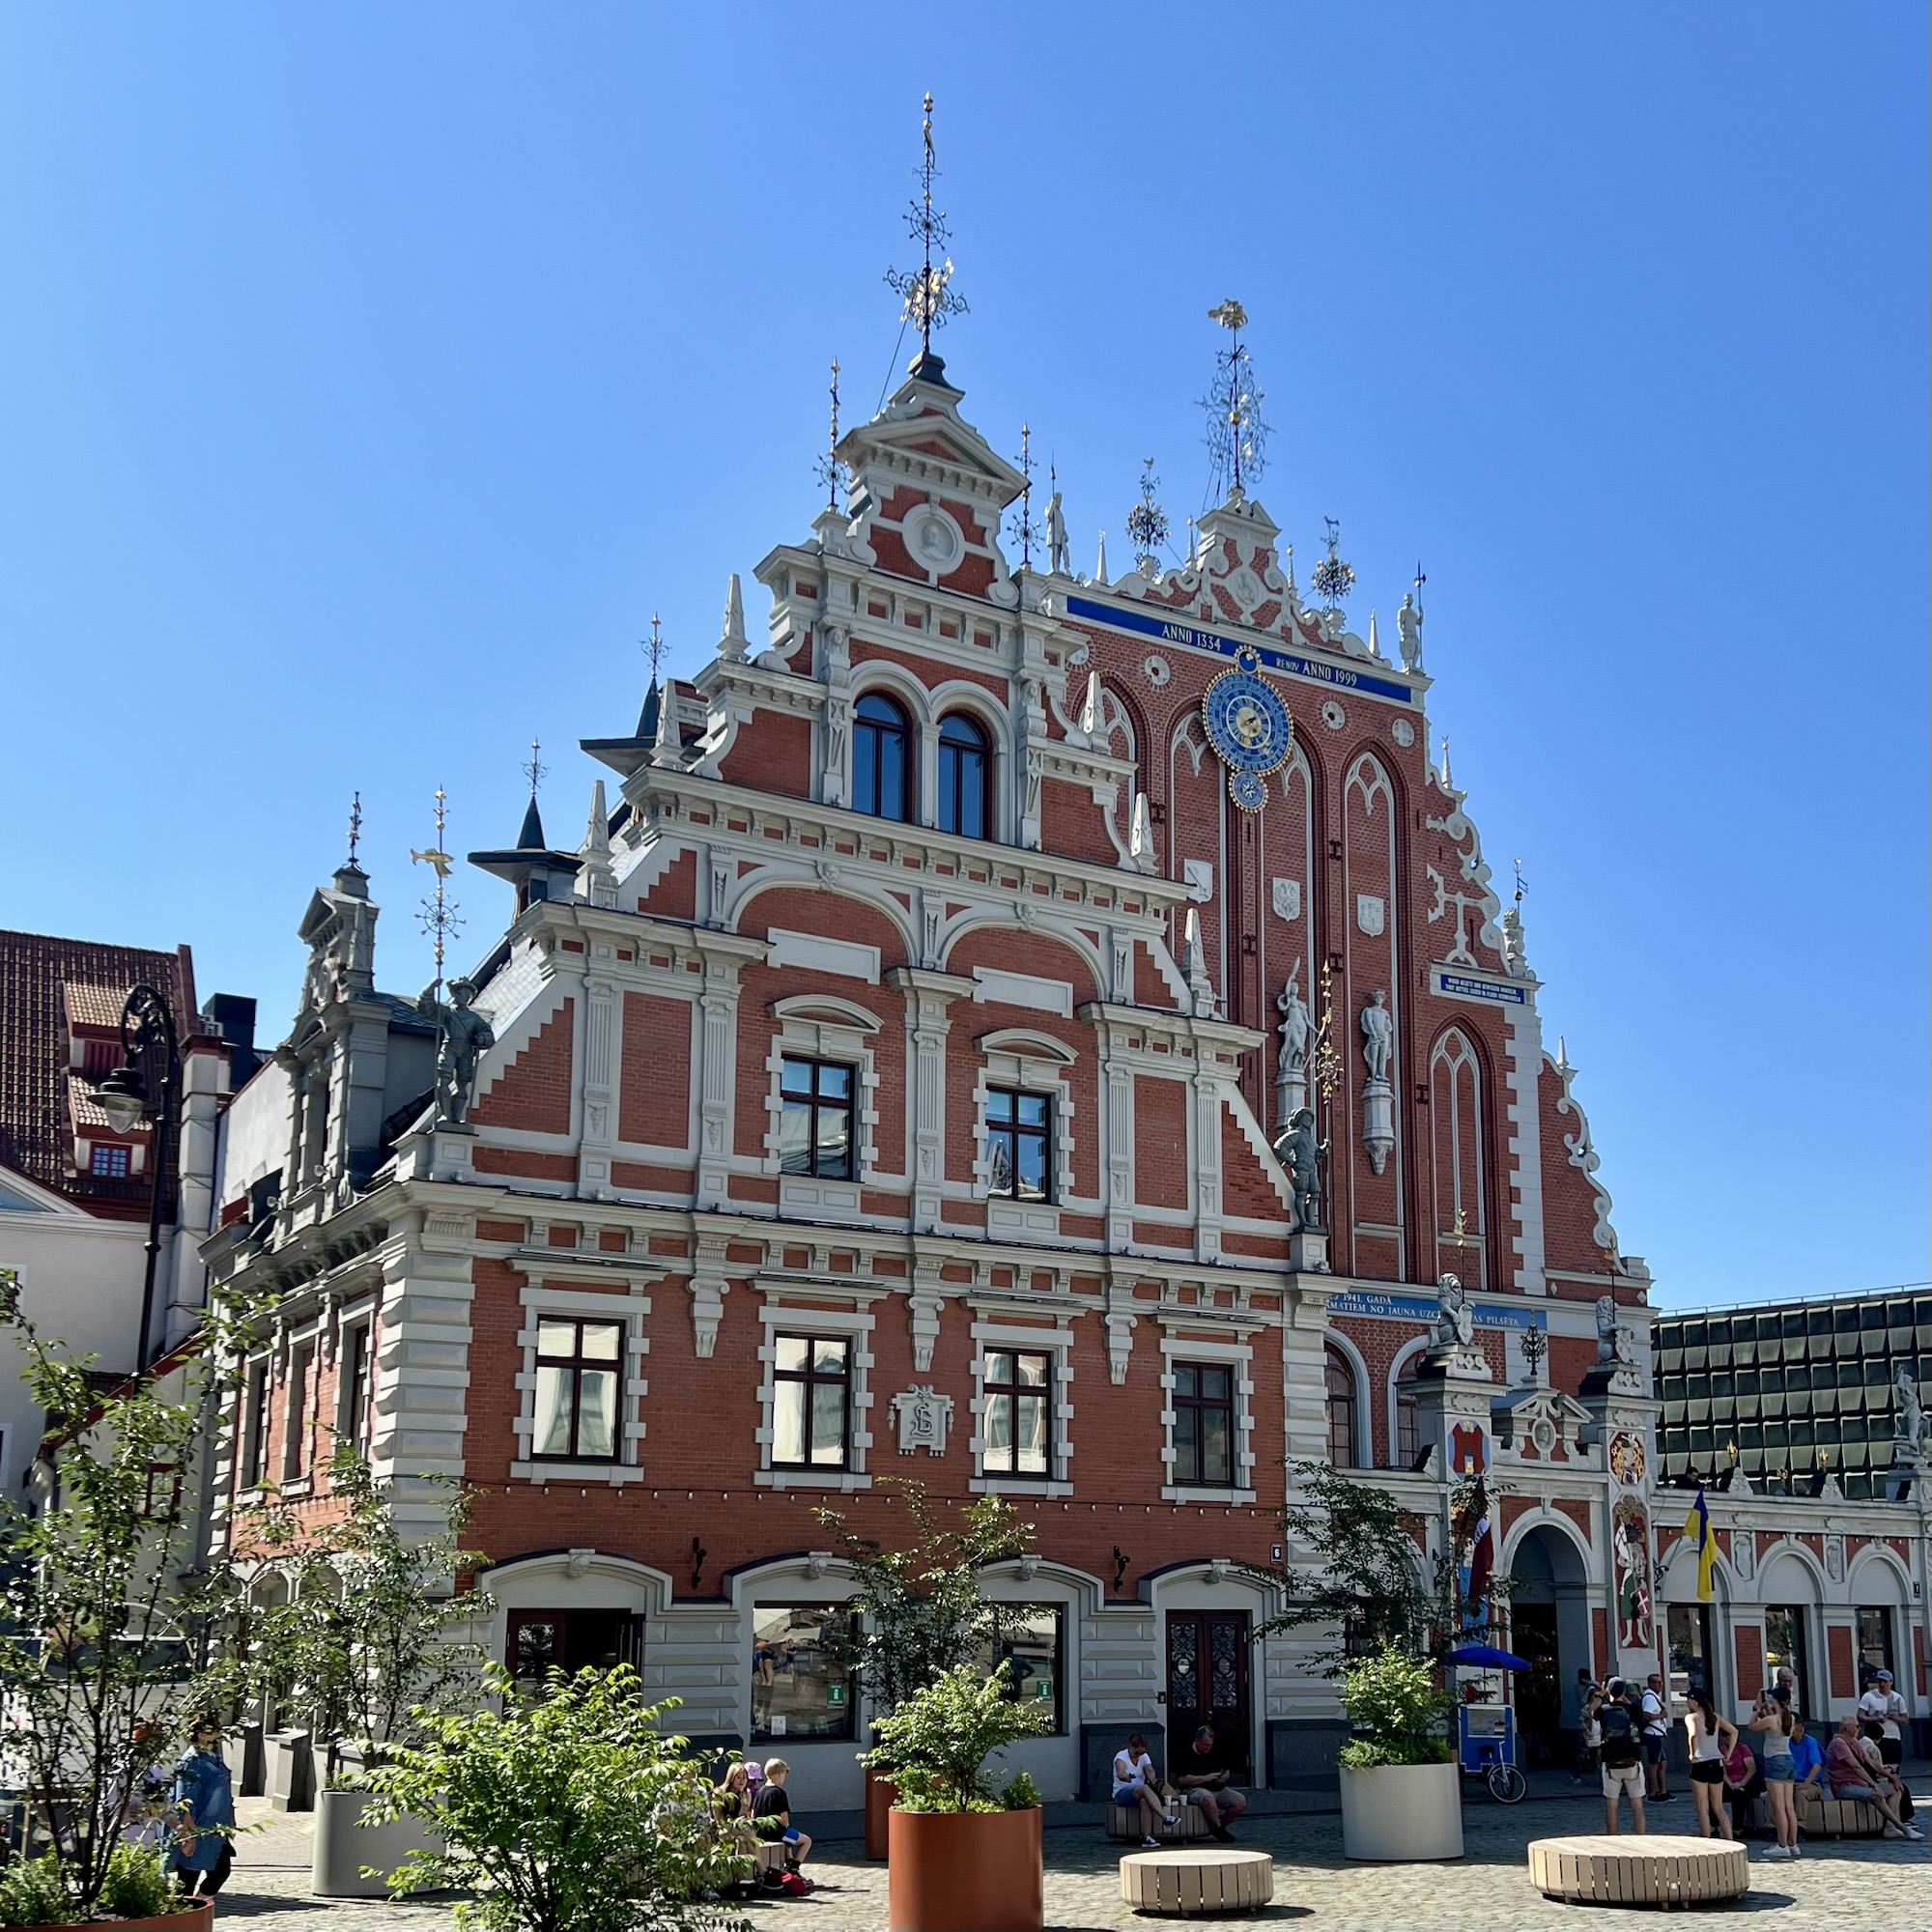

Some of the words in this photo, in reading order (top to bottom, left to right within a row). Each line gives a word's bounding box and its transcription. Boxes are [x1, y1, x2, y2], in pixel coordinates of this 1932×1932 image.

[1161, 624, 1192, 644] ANNO
[1197, 633, 1221, 652] 1334
[1276, 657, 1300, 672] RENOV
[1302, 661, 1331, 681] ANNO
[1335, 669, 1357, 687] 1999
[1370, 1304, 1384, 1314] NO
[1388, 1306, 1416, 1317] JAUNA
[1274, 1548, 1280, 1558] 6
